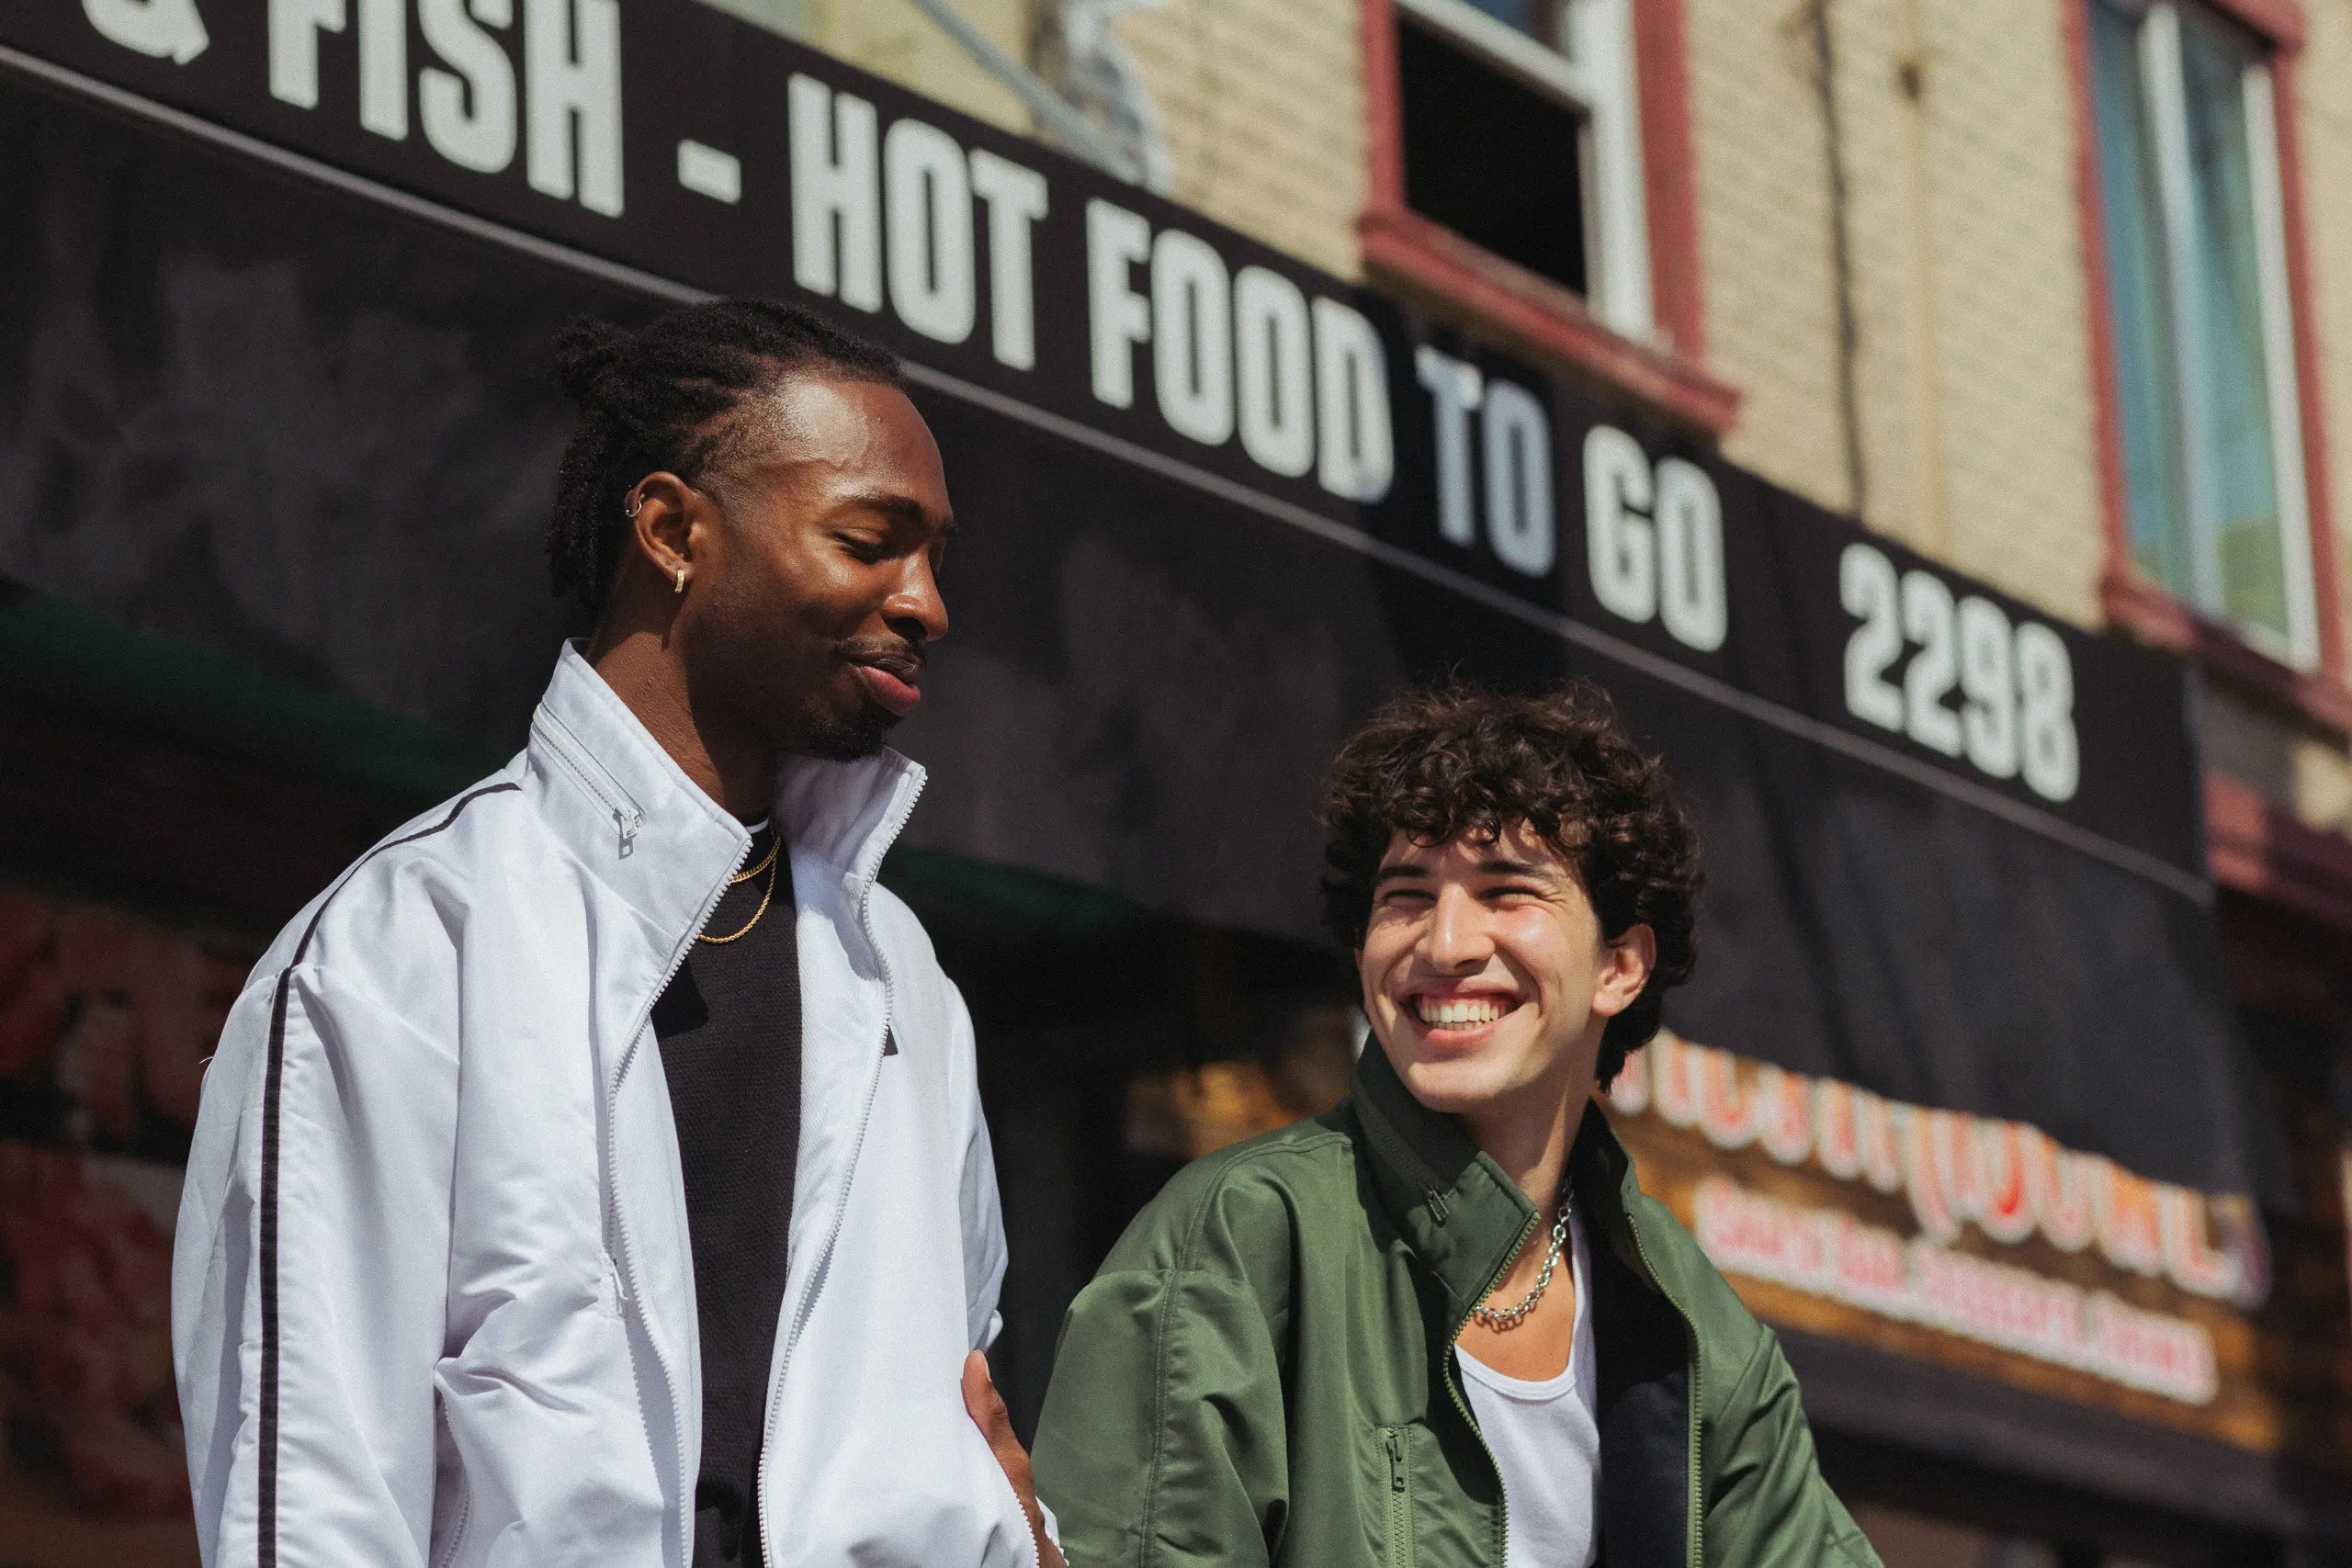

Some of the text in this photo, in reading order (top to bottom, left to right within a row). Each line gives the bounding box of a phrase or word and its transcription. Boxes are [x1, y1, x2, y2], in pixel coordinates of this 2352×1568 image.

[787, 73, 1049, 371] HOT
[1085, 197, 1394, 504] FOOD
[1415, 344, 1555, 578] TO
[1582, 423, 1729, 652] GO
[1838, 542, 2080, 802] 2298
